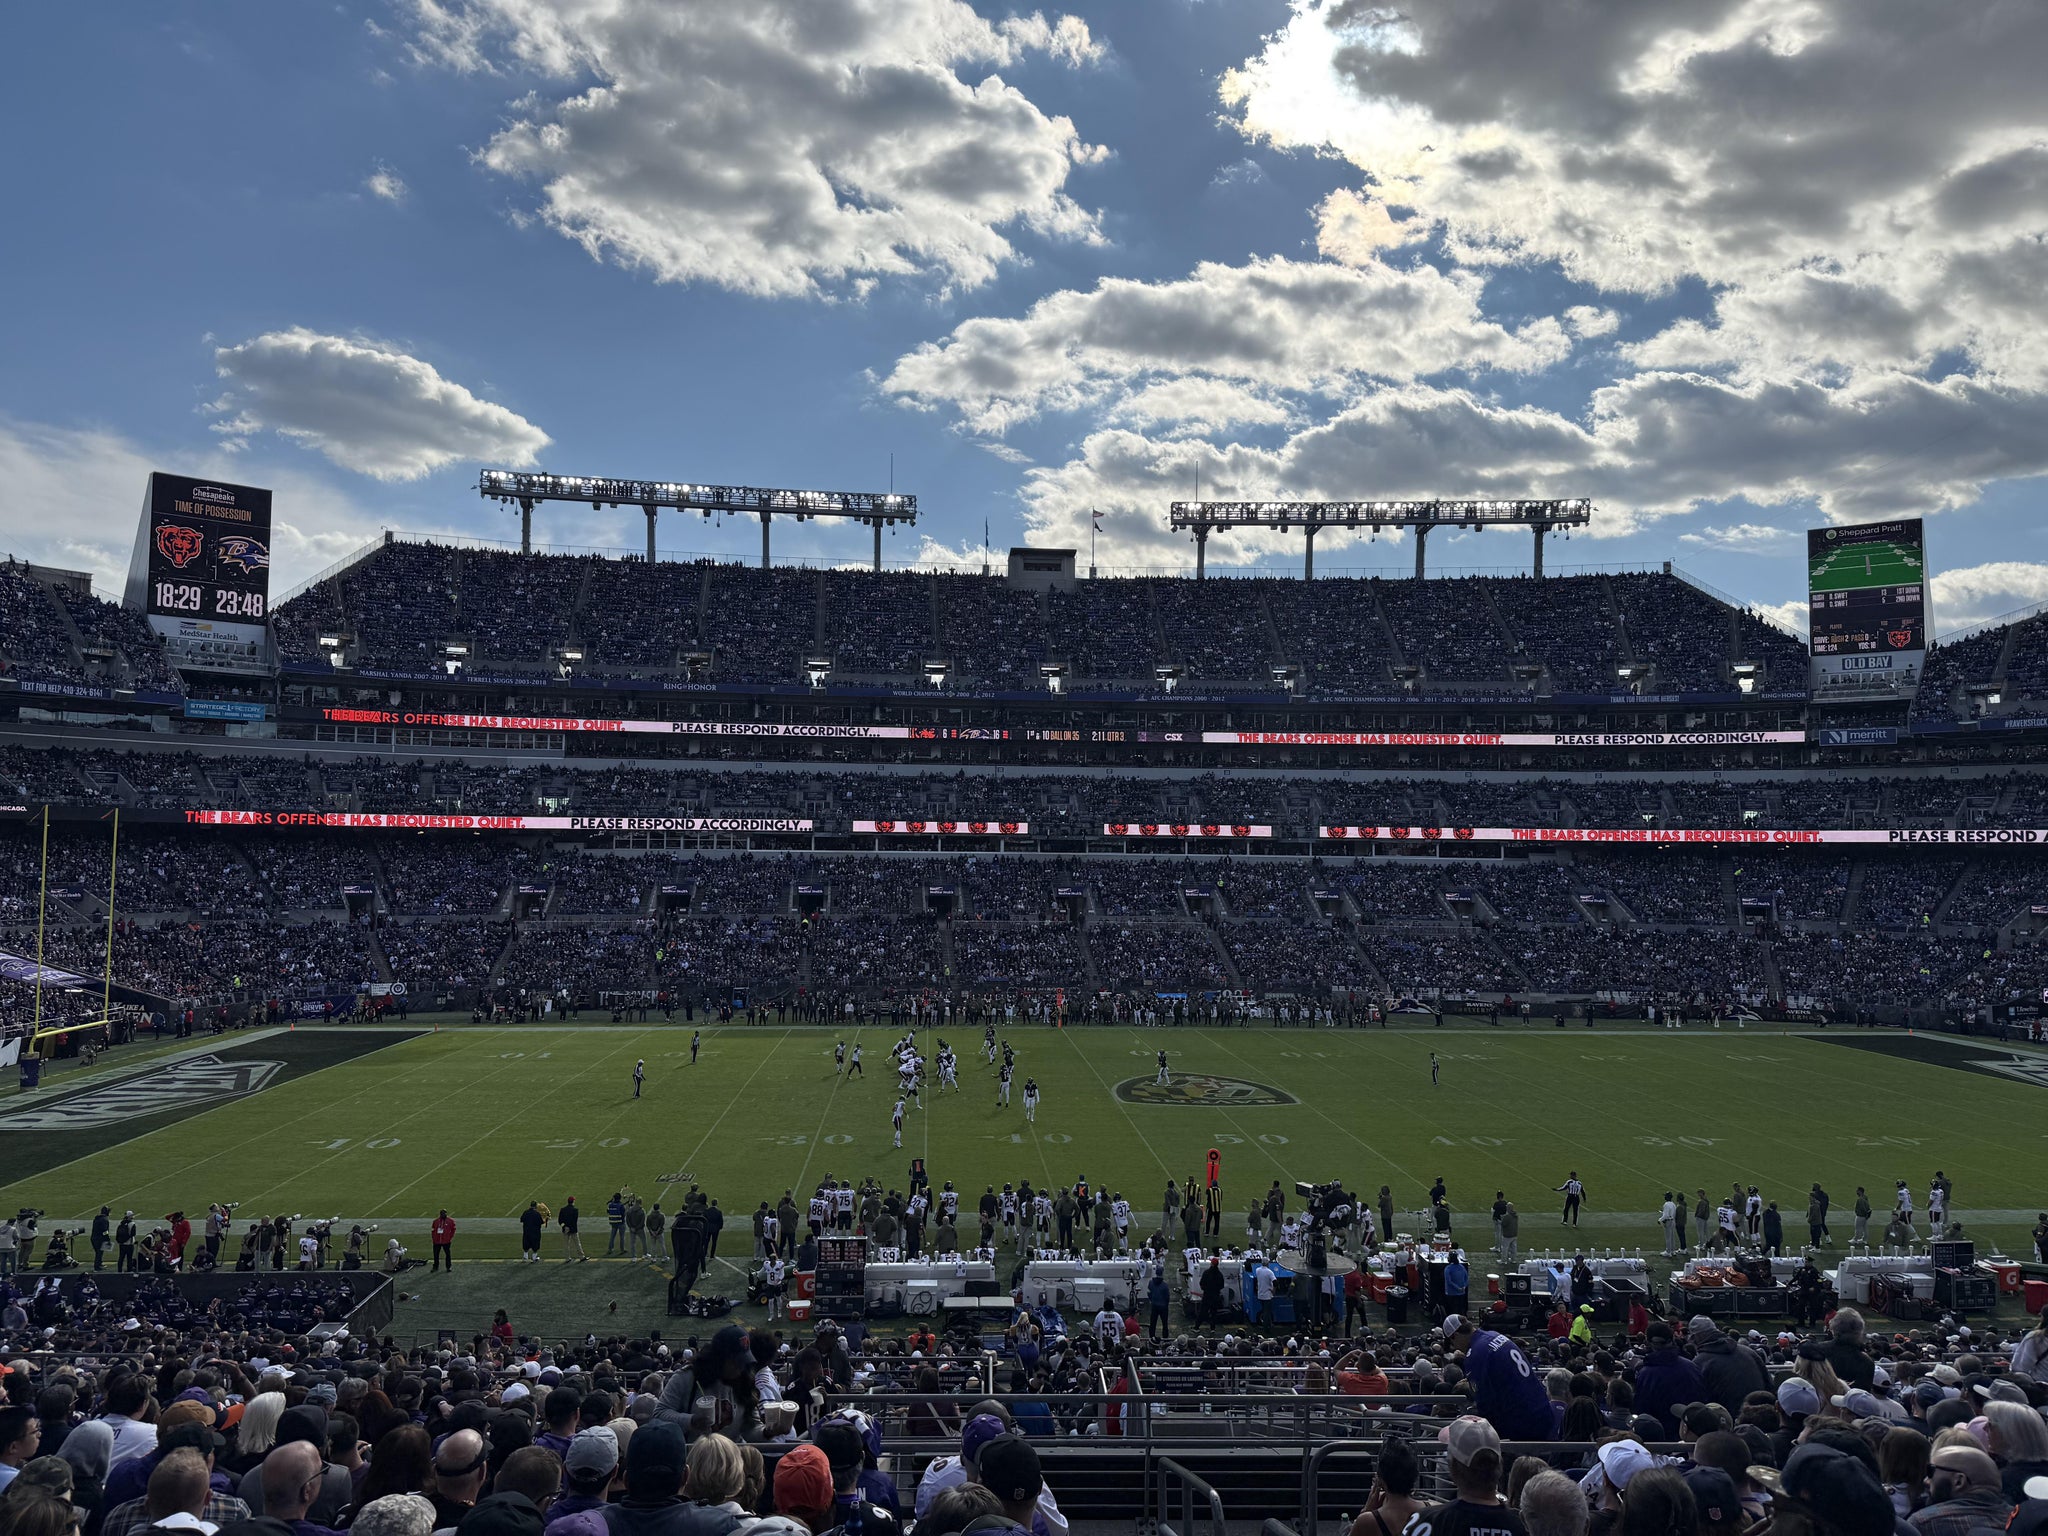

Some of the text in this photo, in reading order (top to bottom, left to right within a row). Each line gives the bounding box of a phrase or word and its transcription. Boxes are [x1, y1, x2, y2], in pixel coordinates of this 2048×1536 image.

[193, 488, 235, 502] Chesapeake
[174, 500, 252, 522] TIME OF POSSESSION
[1838, 524, 1903, 538] Sheppard Pratt
[1905, 586, 1920, 594] DOWN
[155, 583, 201, 611] 18:29
[1905, 594, 1920, 602] DOWN
[216, 590, 263, 617] 23:48
[179, 629, 238, 641] MedStar Health
[1814, 636, 1830, 645] DRIVE:
[1845, 634, 1849, 642] 2
[1814, 644, 1827, 652] TIME:
[1845, 656, 1890, 669] OLD BAY
[359, 670, 389, 679] MARSHAL
[390, 672, 412, 680] YANDA
[467, 675, 547, 686] TERRELL SUGGS 2003-2018
[21, 682, 34, 691] TEXT
[35, 683, 47, 692] FOR
[48, 684, 61, 693] HELP
[663, 683, 683, 691] RING
[687, 683, 717, 691] HONOR
[913, 690, 945, 698] CHAMPIONS
[190, 703, 226, 711] STRATEGIC
[322, 709, 880, 737] THE BEARS OFFENSE HAS REQUESTED QUIET. PLEASE RESPOND ACCORDINGLY...
[943, 728, 948, 738] 6
[993, 729, 999, 739] 16
[1042, 731, 1049, 740] 10
[1050, 731, 1064, 741] BALL
[1064, 731, 1073, 741] ON
[1092, 731, 1105, 741] 2:11
[1106, 731, 1119, 741] QTR
[1164, 732, 1183, 742] CSX
[1237, 732, 1778, 745] THE BEARS OFFENSE HAS REQUESTED QUIET. PLEASE RESPOND ACCORDINGLY...
[1850, 729, 1887, 740] merritt
[184, 810, 812, 831] THE BEARS OFFENSE HAS REQUESTED QUIET. PLEASE RESPOND ACCORDINGLY...
[1511, 829, 1537, 839] THE
[1540, 830, 1584, 841] BEARS
[1587, 830, 1648, 841] OFFENSE
[1651, 830, 1681, 841] HAS
[1684, 830, 1769, 842] REQUESTED
[1773, 831, 1823, 842] QUIET.
[1889, 830, 1949, 842] PLEASE
[1954, 831, 2037, 842] RESPOND
[317, 1138, 401, 1150] 10
[545, 1136, 630, 1149] 20
[776, 1134, 854, 1147] 30
[1213, 1133, 1290, 1145] 50
[838, 1196, 851, 1207] 75
[1004, 1196, 1014, 1208] 25
[812, 1204, 823, 1216] 88
[1117, 1205, 1127, 1218] 37
[2006, 1271, 2016, 1285] G
[803, 1278, 815, 1292] G
[795, 1309, 803, 1319] G
[1102, 1321, 1117, 1337] 55
[1510, 1349, 1530, 1378] 8
